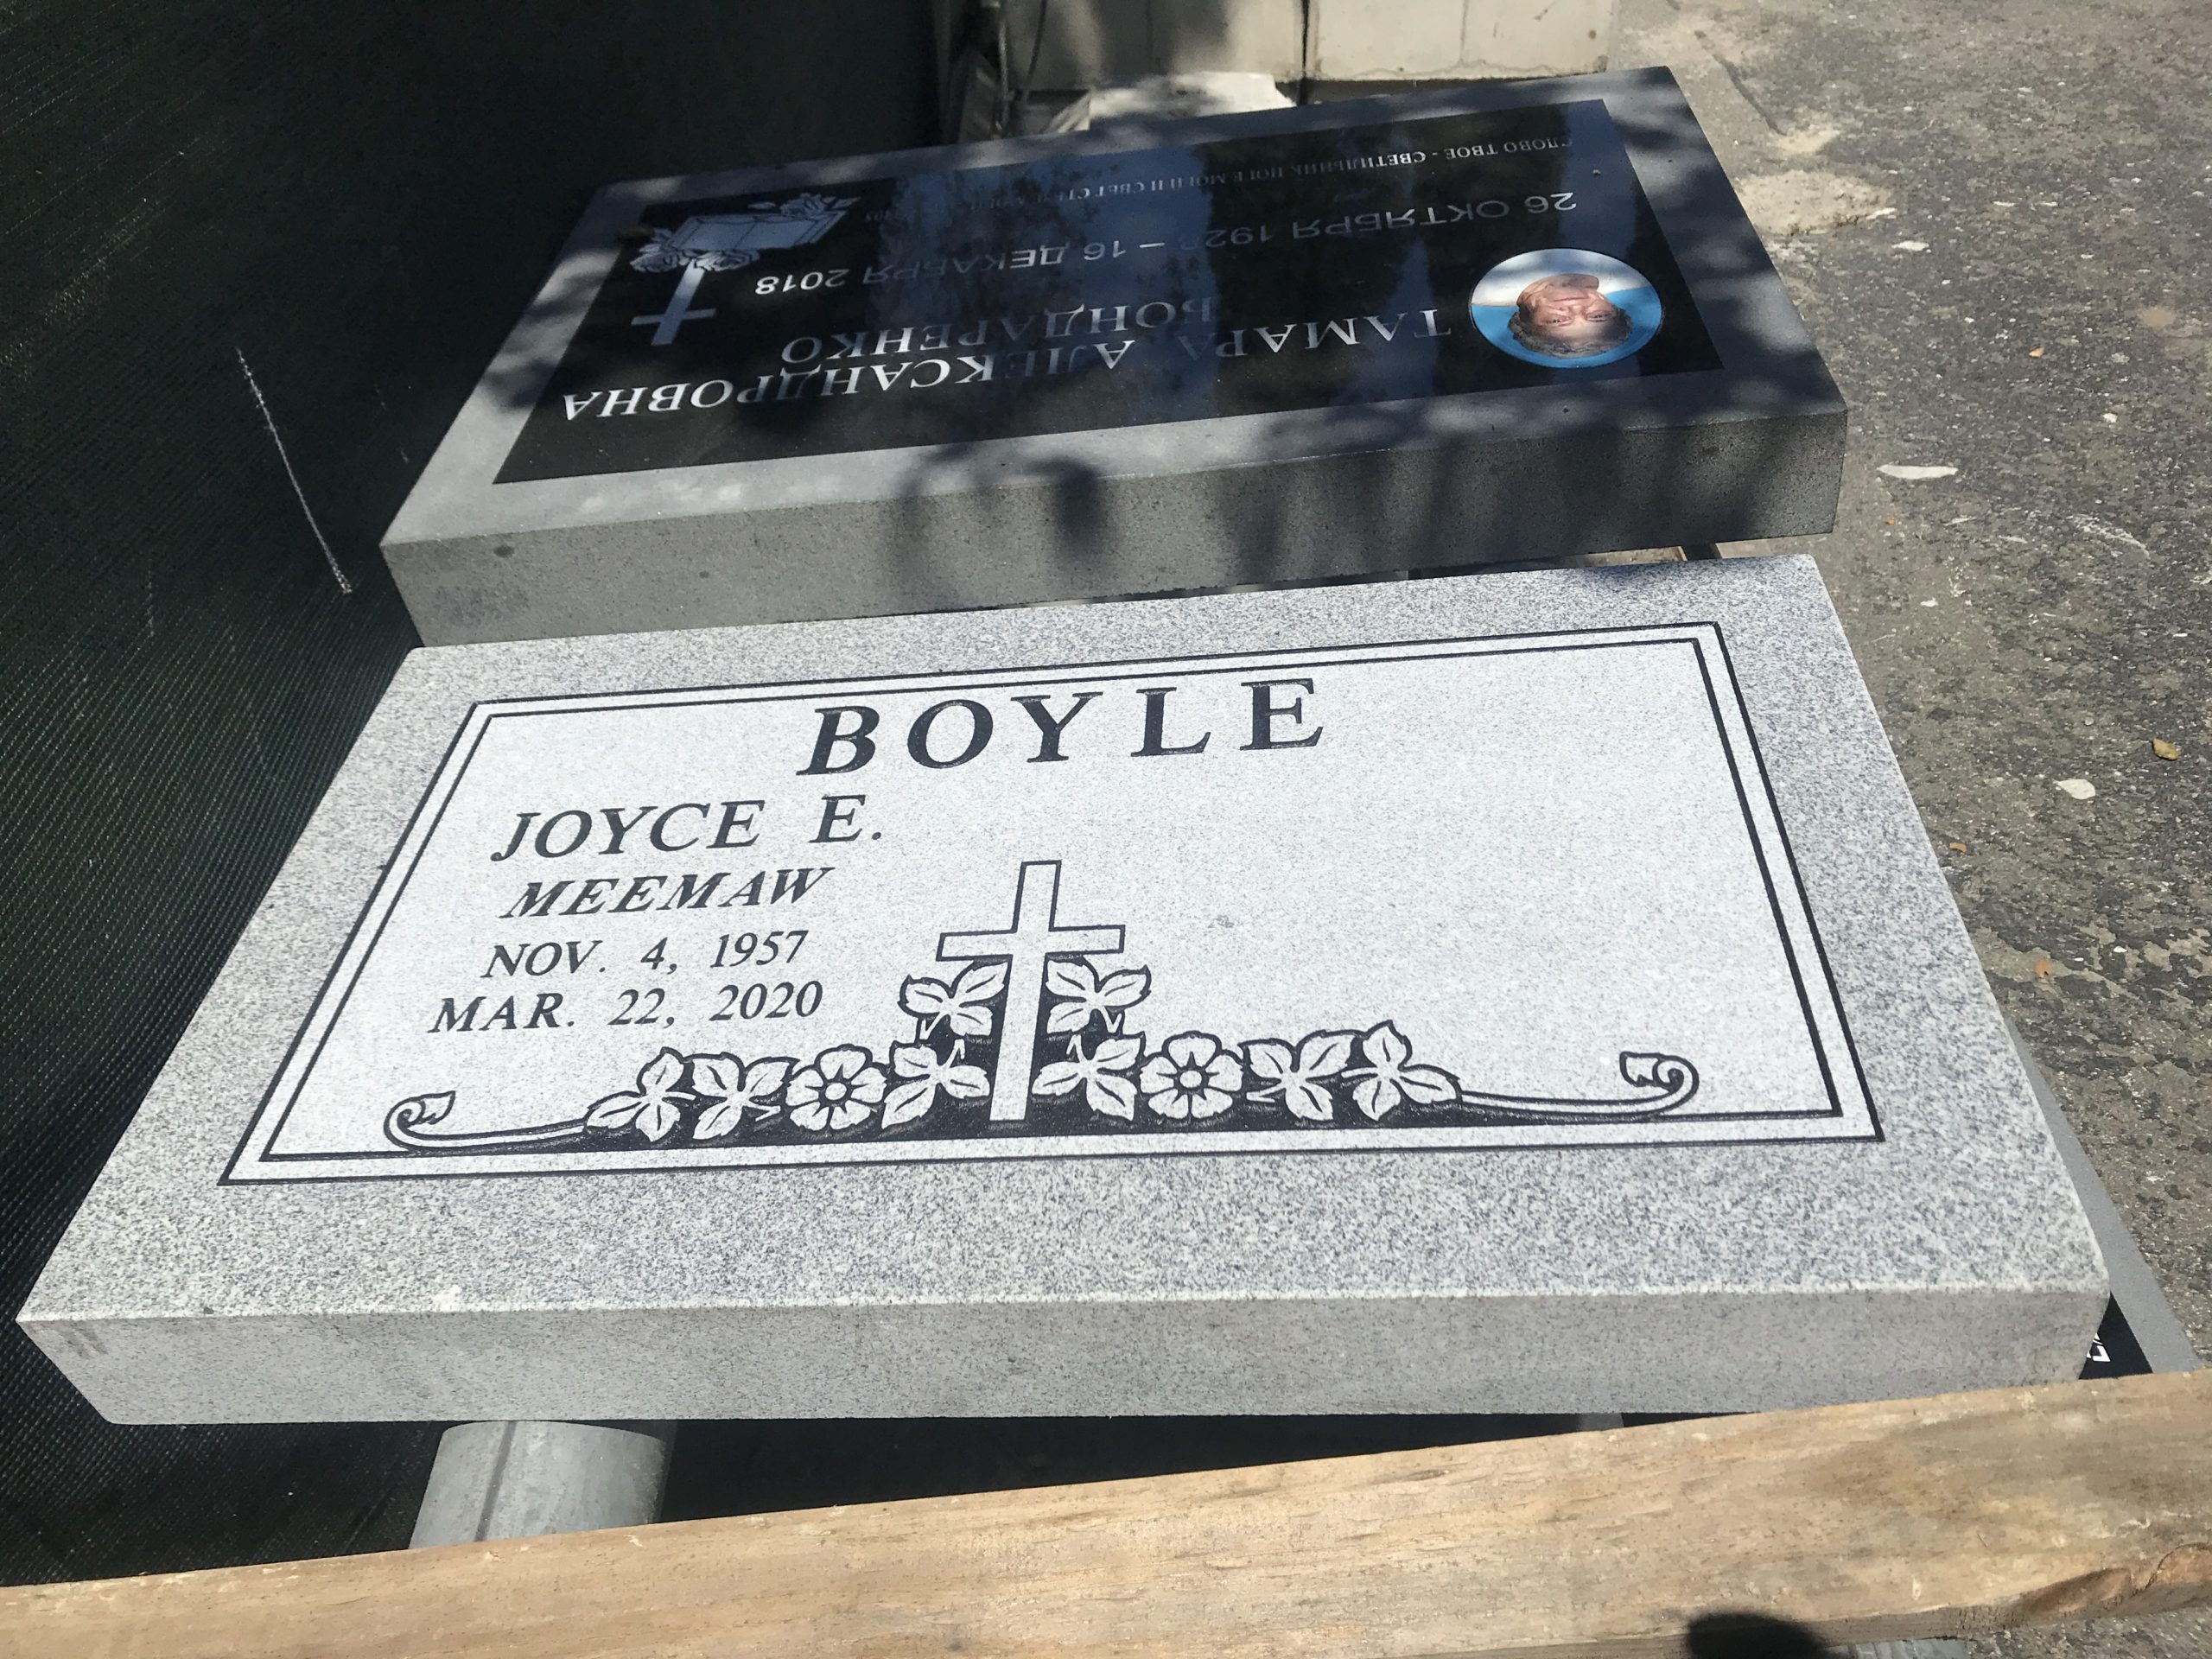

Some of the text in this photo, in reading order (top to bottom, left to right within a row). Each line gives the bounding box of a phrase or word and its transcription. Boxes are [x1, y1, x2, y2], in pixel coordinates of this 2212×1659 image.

[1289, 150, 1427, 175] СВЕТИЛЬНИК
[1443, 143, 1498, 160] ТВОЕ
[1292, 199, 1511, 239] ОКТЯБРЯ
[1524, 191, 1578, 214] 26
[861, 243, 1071, 285] ДЕКАБРЯ
[1083, 239, 1127, 262] 16
[754, 267, 851, 296] 2018
[781, 296, 1215, 364] БОНДАРЕНКО
[562, 307, 1452, 422] ТАМАРА АЛЕКСАНДРОВНА
[795, 677, 1324, 776] BOYLE
[490, 794, 883, 861] JOYCE E.
[498, 867, 836, 918] MEEMAW
[480, 930, 809, 978] NOV. 4, 1957
[427, 980, 824, 1033] MAR. 22, 2020
